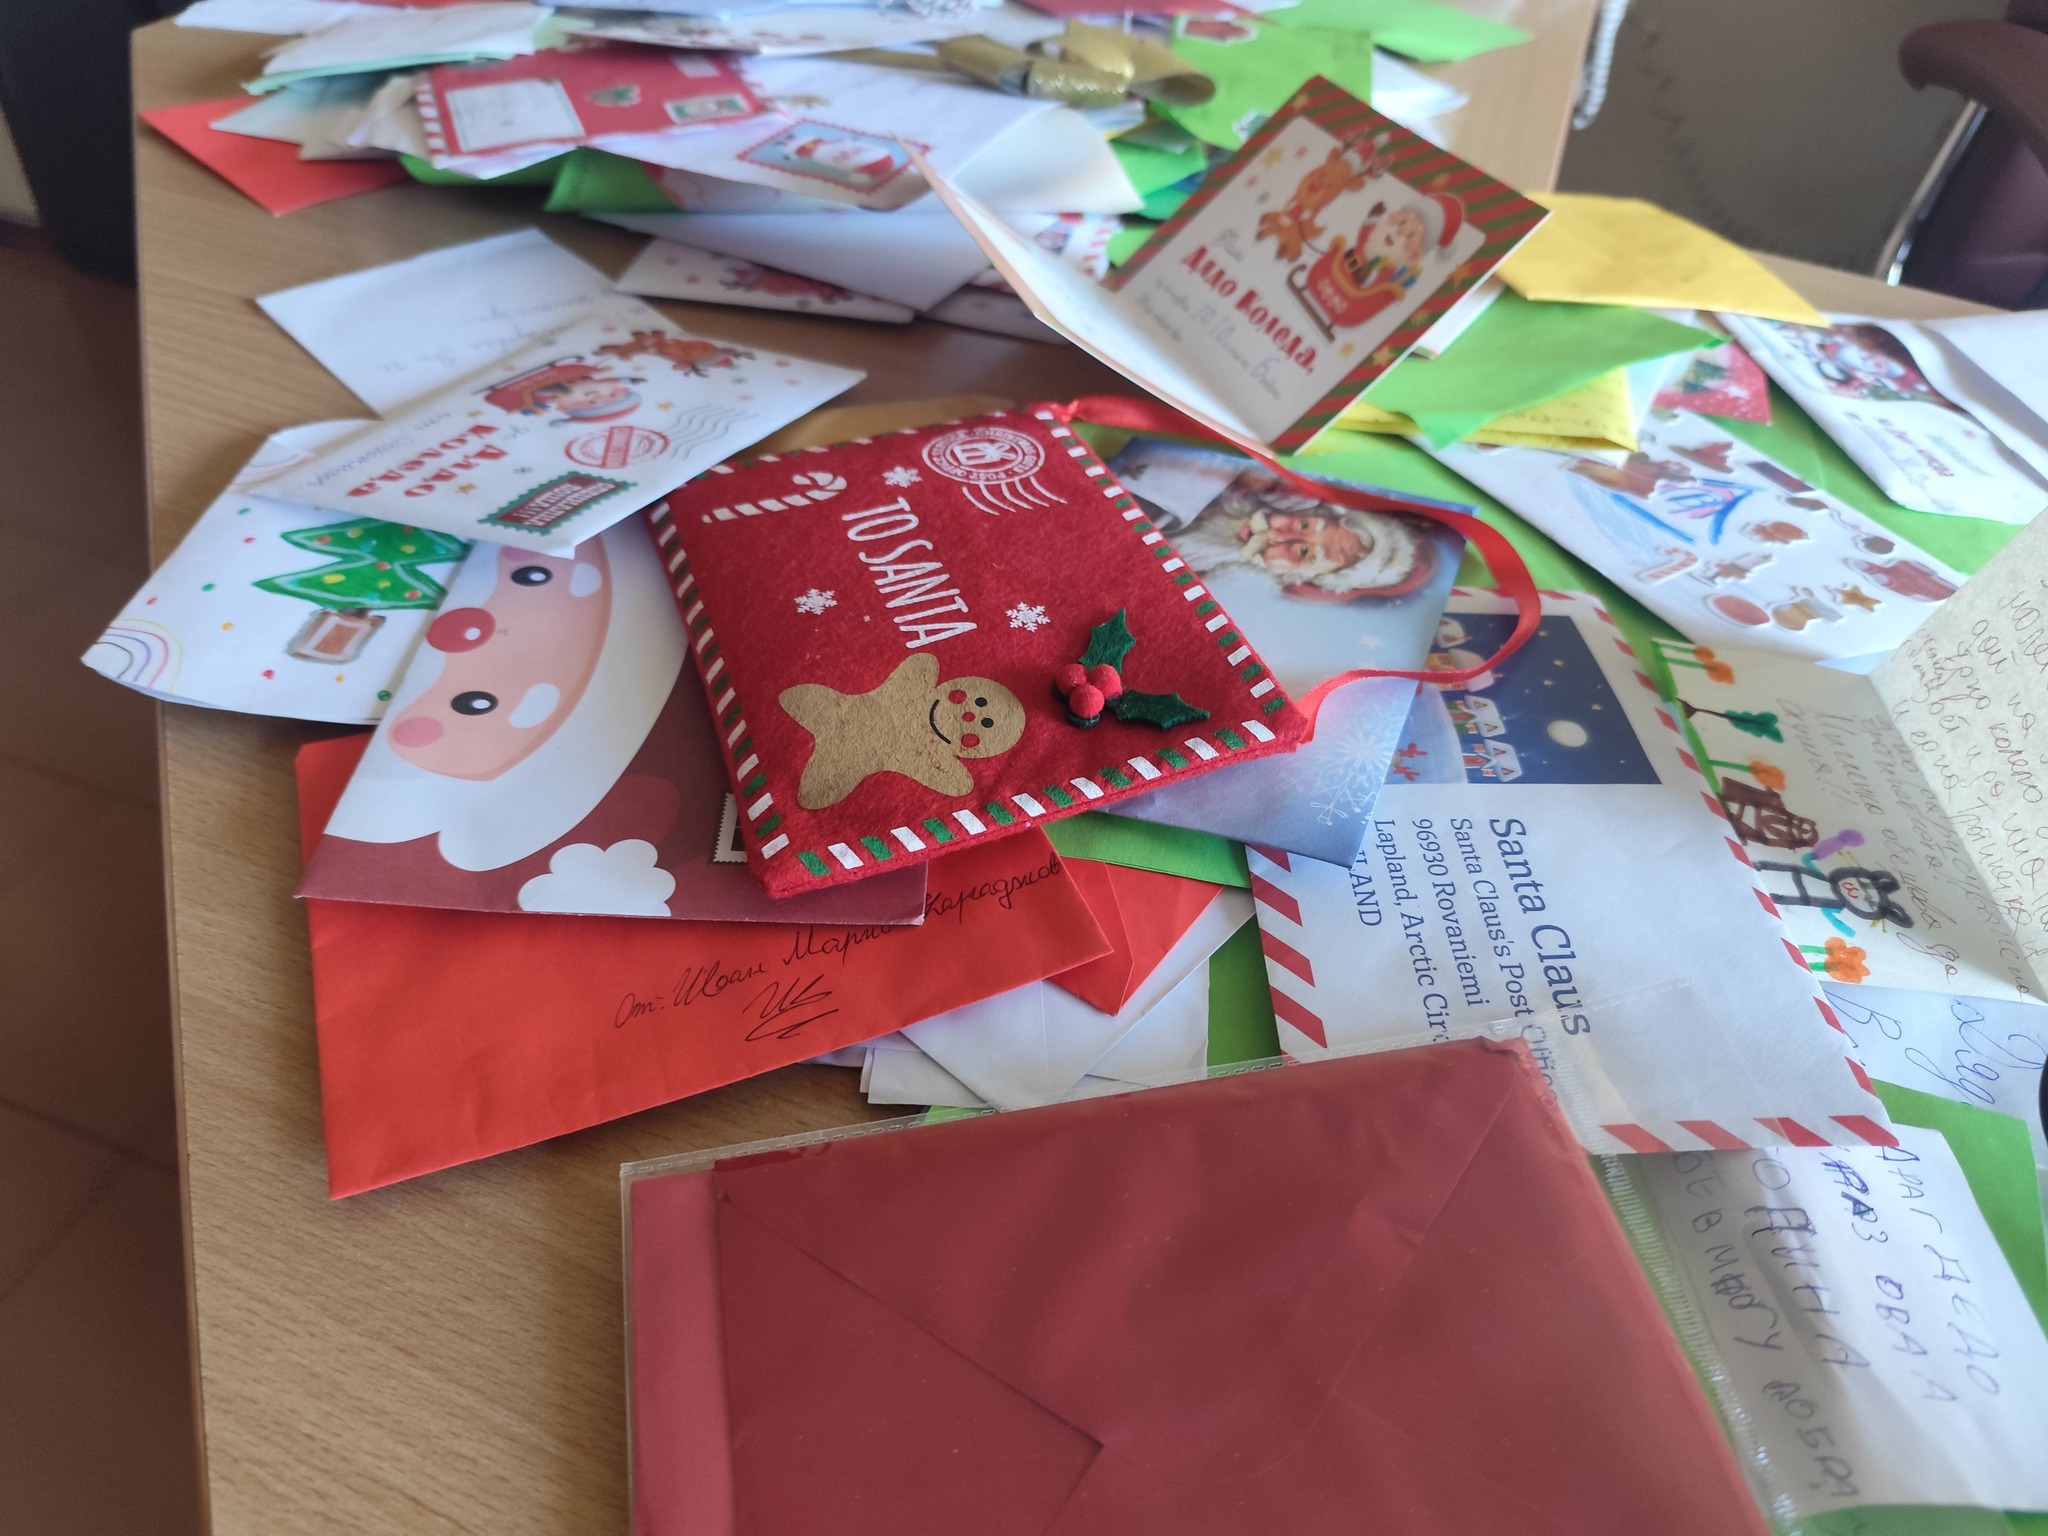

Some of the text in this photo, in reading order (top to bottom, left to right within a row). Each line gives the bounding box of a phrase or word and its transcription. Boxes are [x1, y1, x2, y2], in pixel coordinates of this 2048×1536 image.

[841, 496, 978, 649] TO SANTA
[1374, 819, 1418, 907] Lapland,
[1400, 911, 1438, 987] Arctic
[1412, 818, 1491, 1008] 96930 Rovaniemi
[1450, 818, 1483, 875] Santa
[1472, 880, 1512, 957] Claus's
[1498, 962, 1535, 1017] Post
[1489, 818, 1591, 1035] Santa Claus
[1744, 1150, 1872, 1368] ОДИНА
